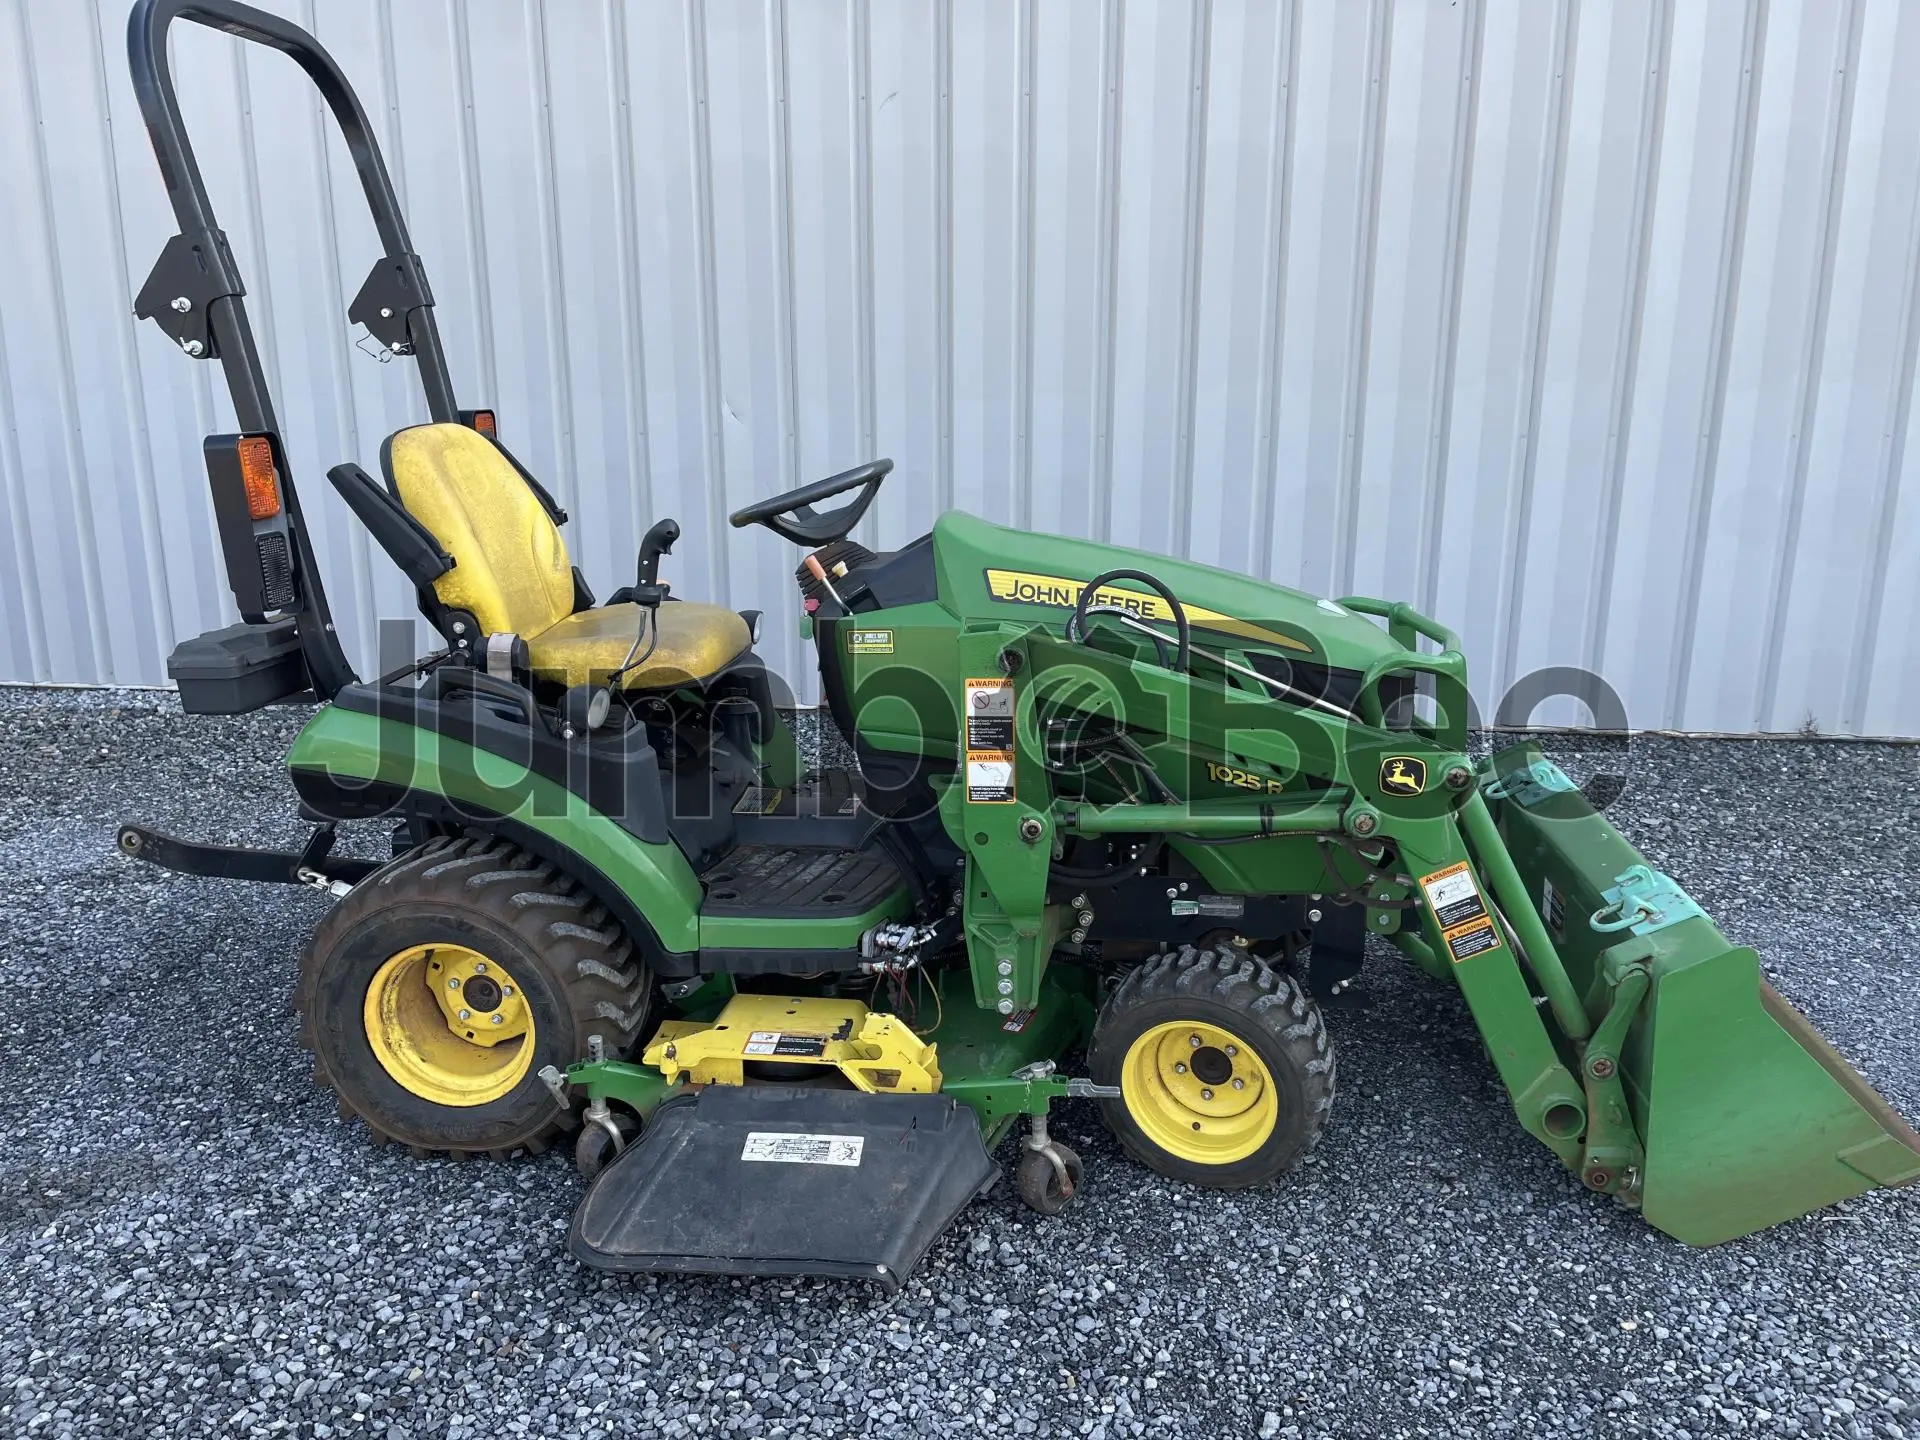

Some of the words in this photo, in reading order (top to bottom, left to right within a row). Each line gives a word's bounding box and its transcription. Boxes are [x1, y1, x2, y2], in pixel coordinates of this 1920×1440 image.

[1005, 579, 1069, 604] JOHN
[1432, 865, 1463, 880] WARNING
[1457, 920, 1487, 935] WARNING
